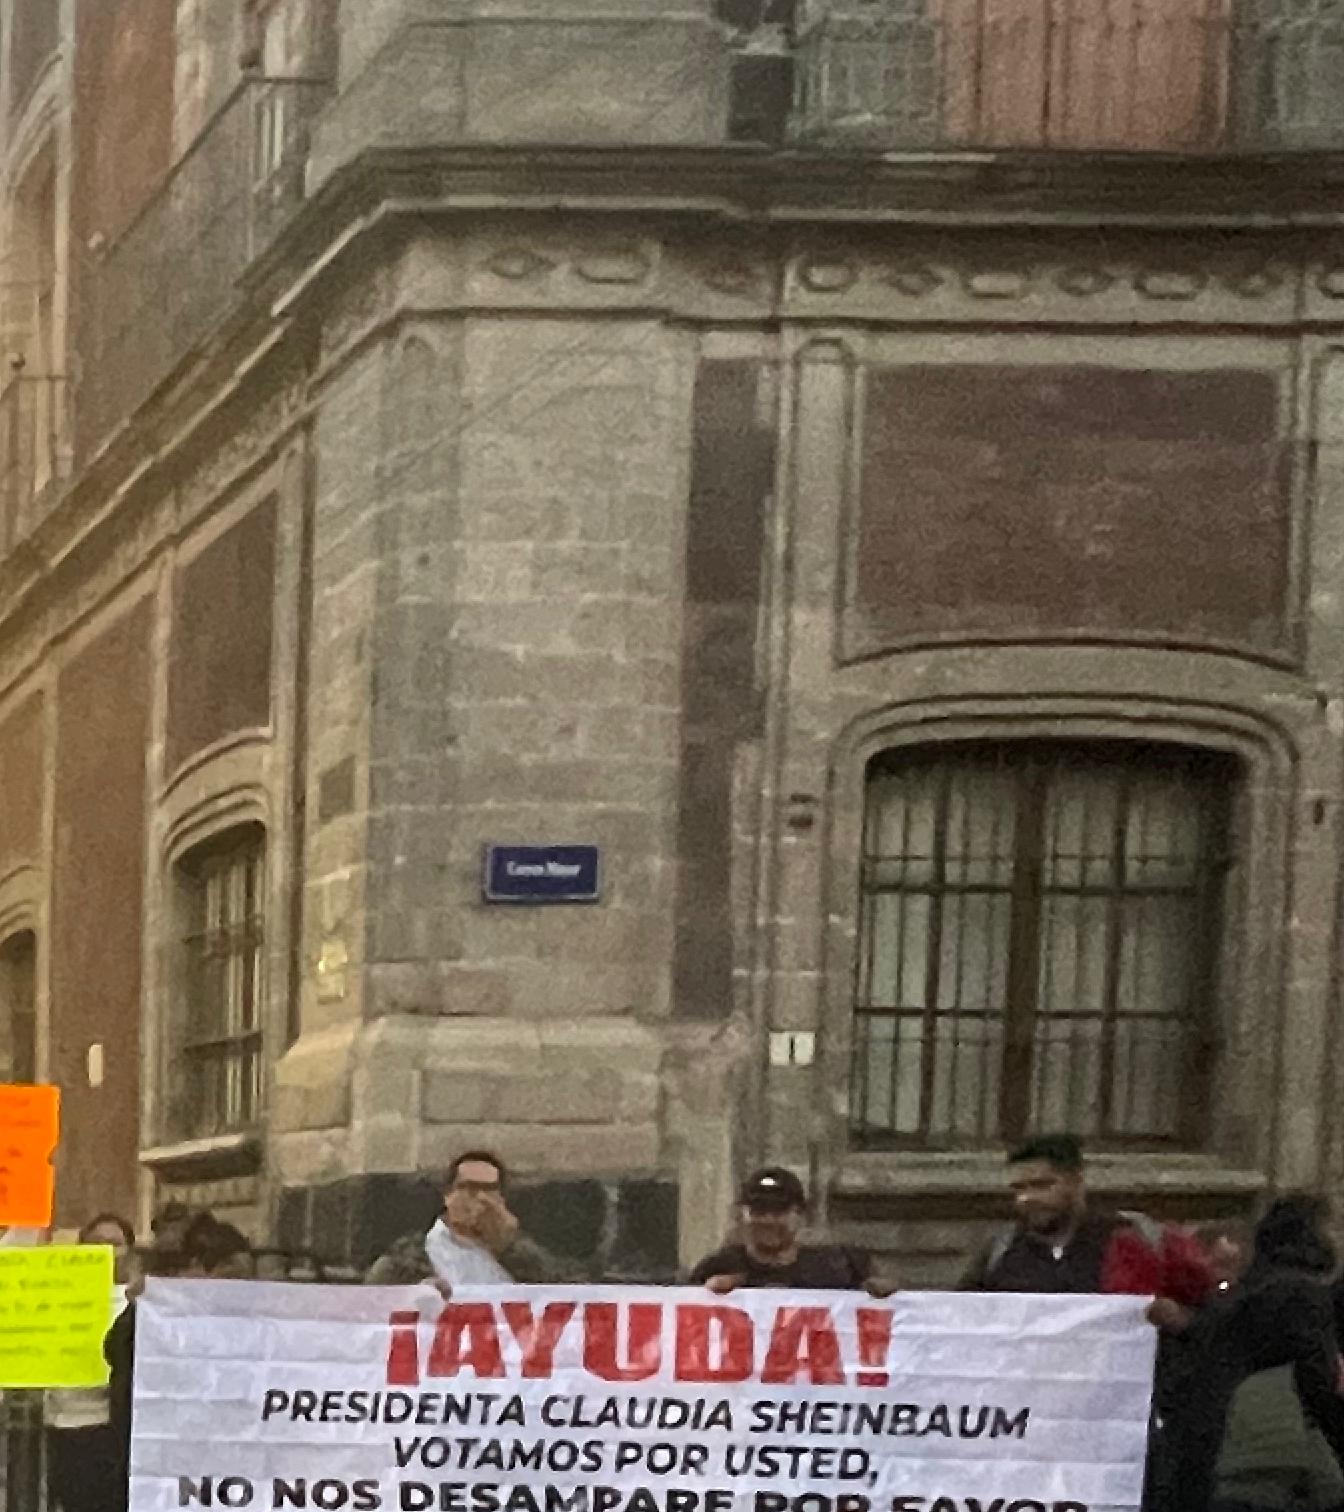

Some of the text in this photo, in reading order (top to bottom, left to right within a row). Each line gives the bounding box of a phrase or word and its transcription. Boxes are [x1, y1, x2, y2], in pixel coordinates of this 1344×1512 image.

[386, 1302, 895, 1387] ¡AYUDA!
[262, 1389, 1030, 1439] PRESIDENTA CLAUDIA SHEINBAUM
[395, 1436, 878, 1488] VOTAMOS POR USTED,
[178, 1476, 254, 1508] NO
[273, 1478, 382, 1512] NOS
